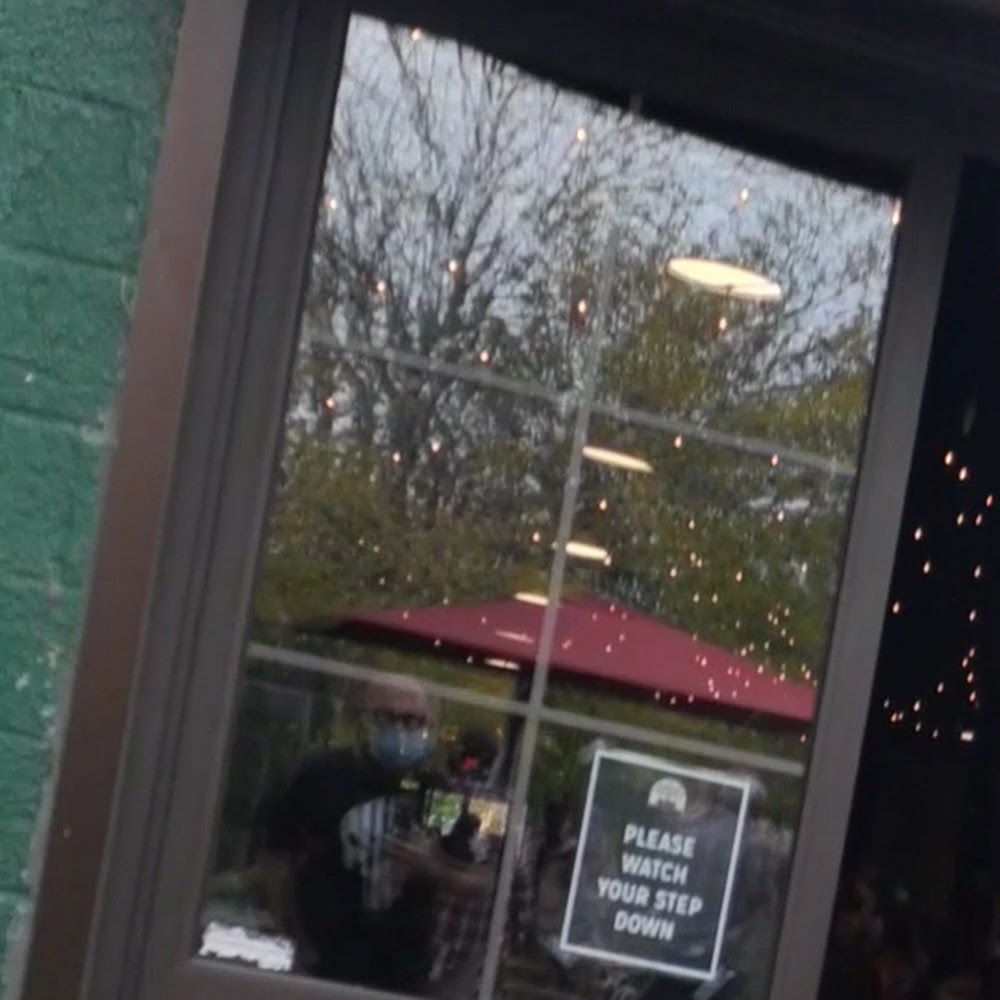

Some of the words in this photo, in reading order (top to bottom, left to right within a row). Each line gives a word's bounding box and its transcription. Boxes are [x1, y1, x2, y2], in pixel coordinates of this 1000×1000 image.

[623, 823, 696, 858] PLEASE
[621, 852, 689, 886] WATCH
[598, 876, 650, 907] YOUR
[653, 889, 703, 917] STEP
[613, 910, 675, 941] DOWN
